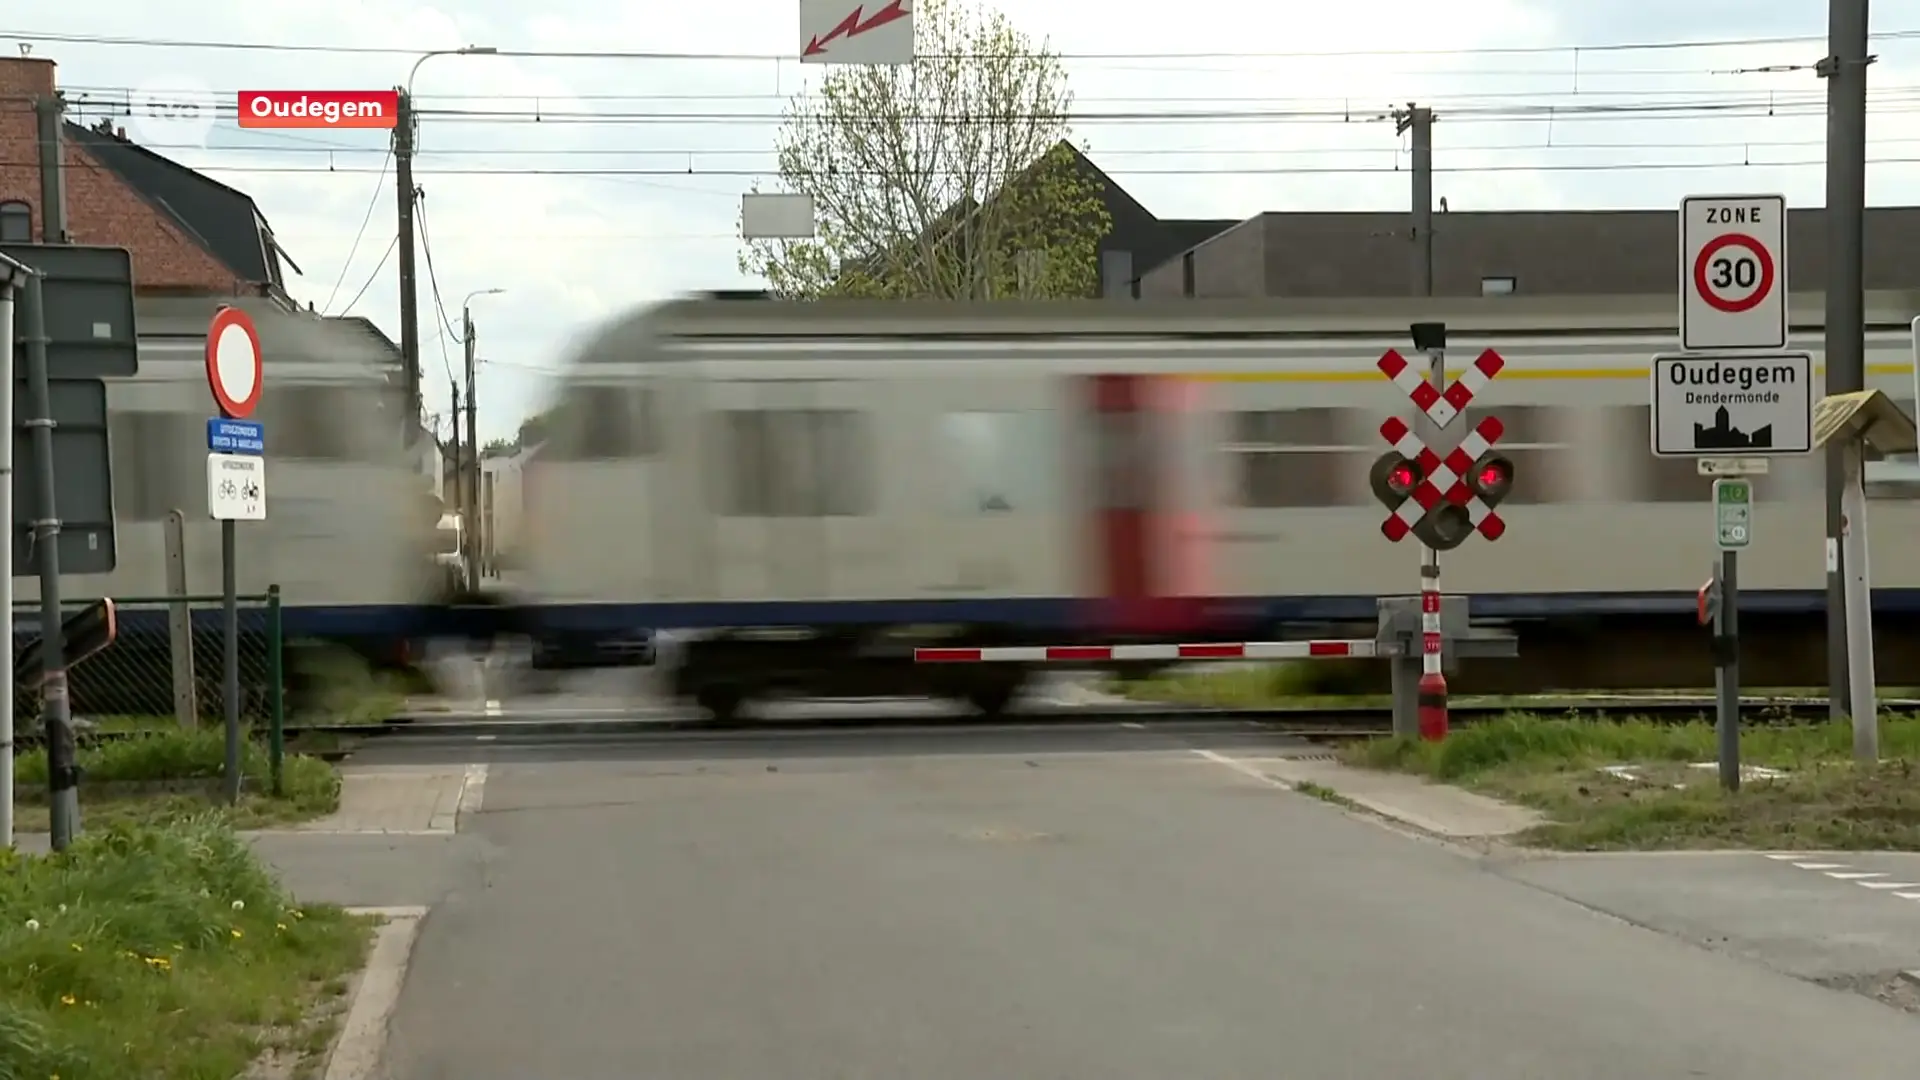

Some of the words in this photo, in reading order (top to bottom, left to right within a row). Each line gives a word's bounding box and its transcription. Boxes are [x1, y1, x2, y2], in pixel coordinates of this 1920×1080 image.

[1706, 207, 1761, 224] ZONE
[1711, 258, 1756, 288] 30
[1670, 362, 1796, 390] Oudegem
[1685, 391, 1780, 405] Dendermonde
